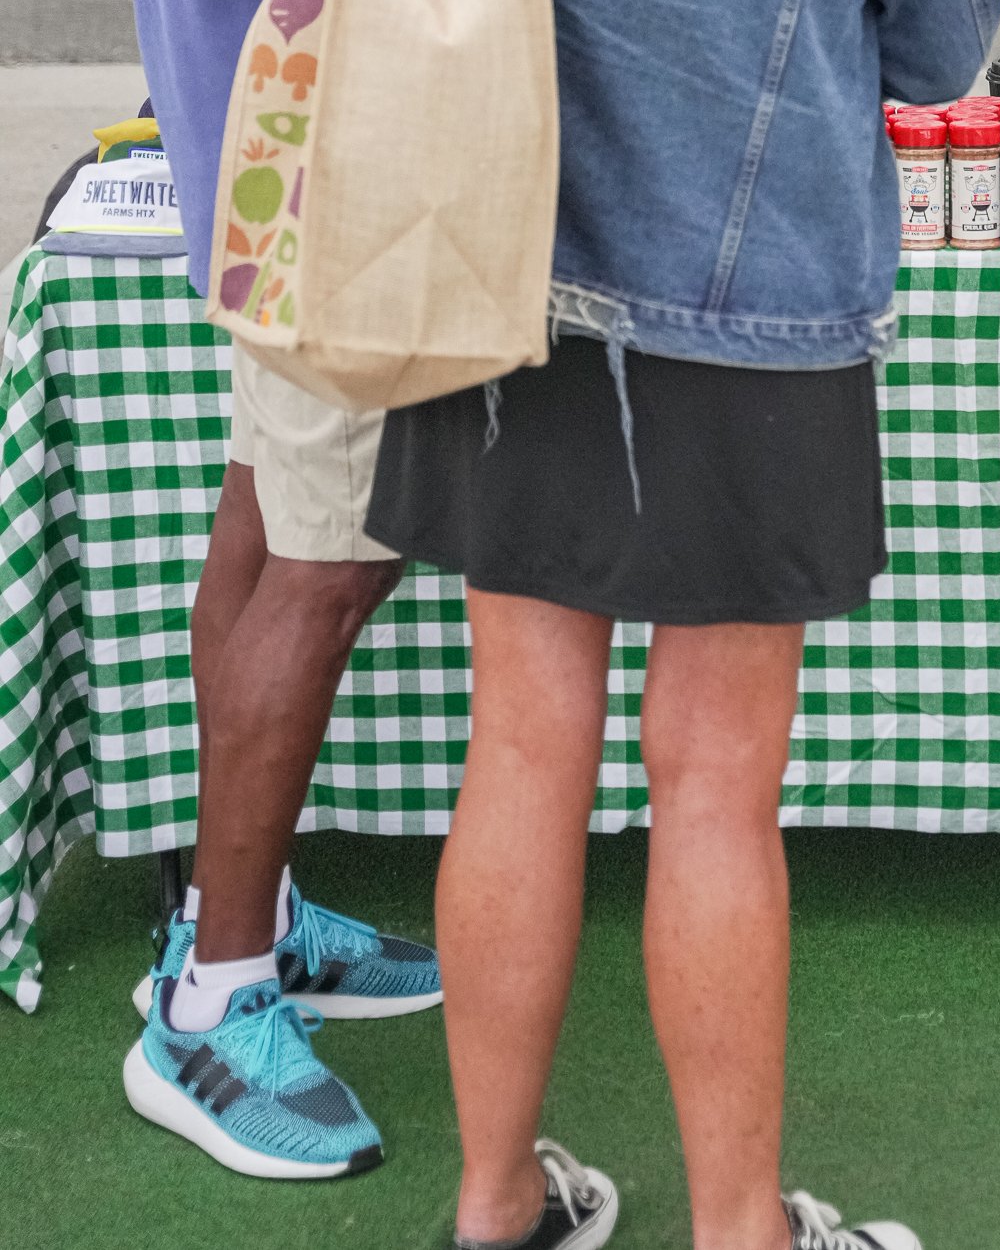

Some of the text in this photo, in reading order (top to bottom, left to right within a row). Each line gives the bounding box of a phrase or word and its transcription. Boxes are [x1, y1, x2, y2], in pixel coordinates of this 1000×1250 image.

[83, 180, 179, 208] SWEETWATE
[102, 208, 155, 218] FARMS HTX
